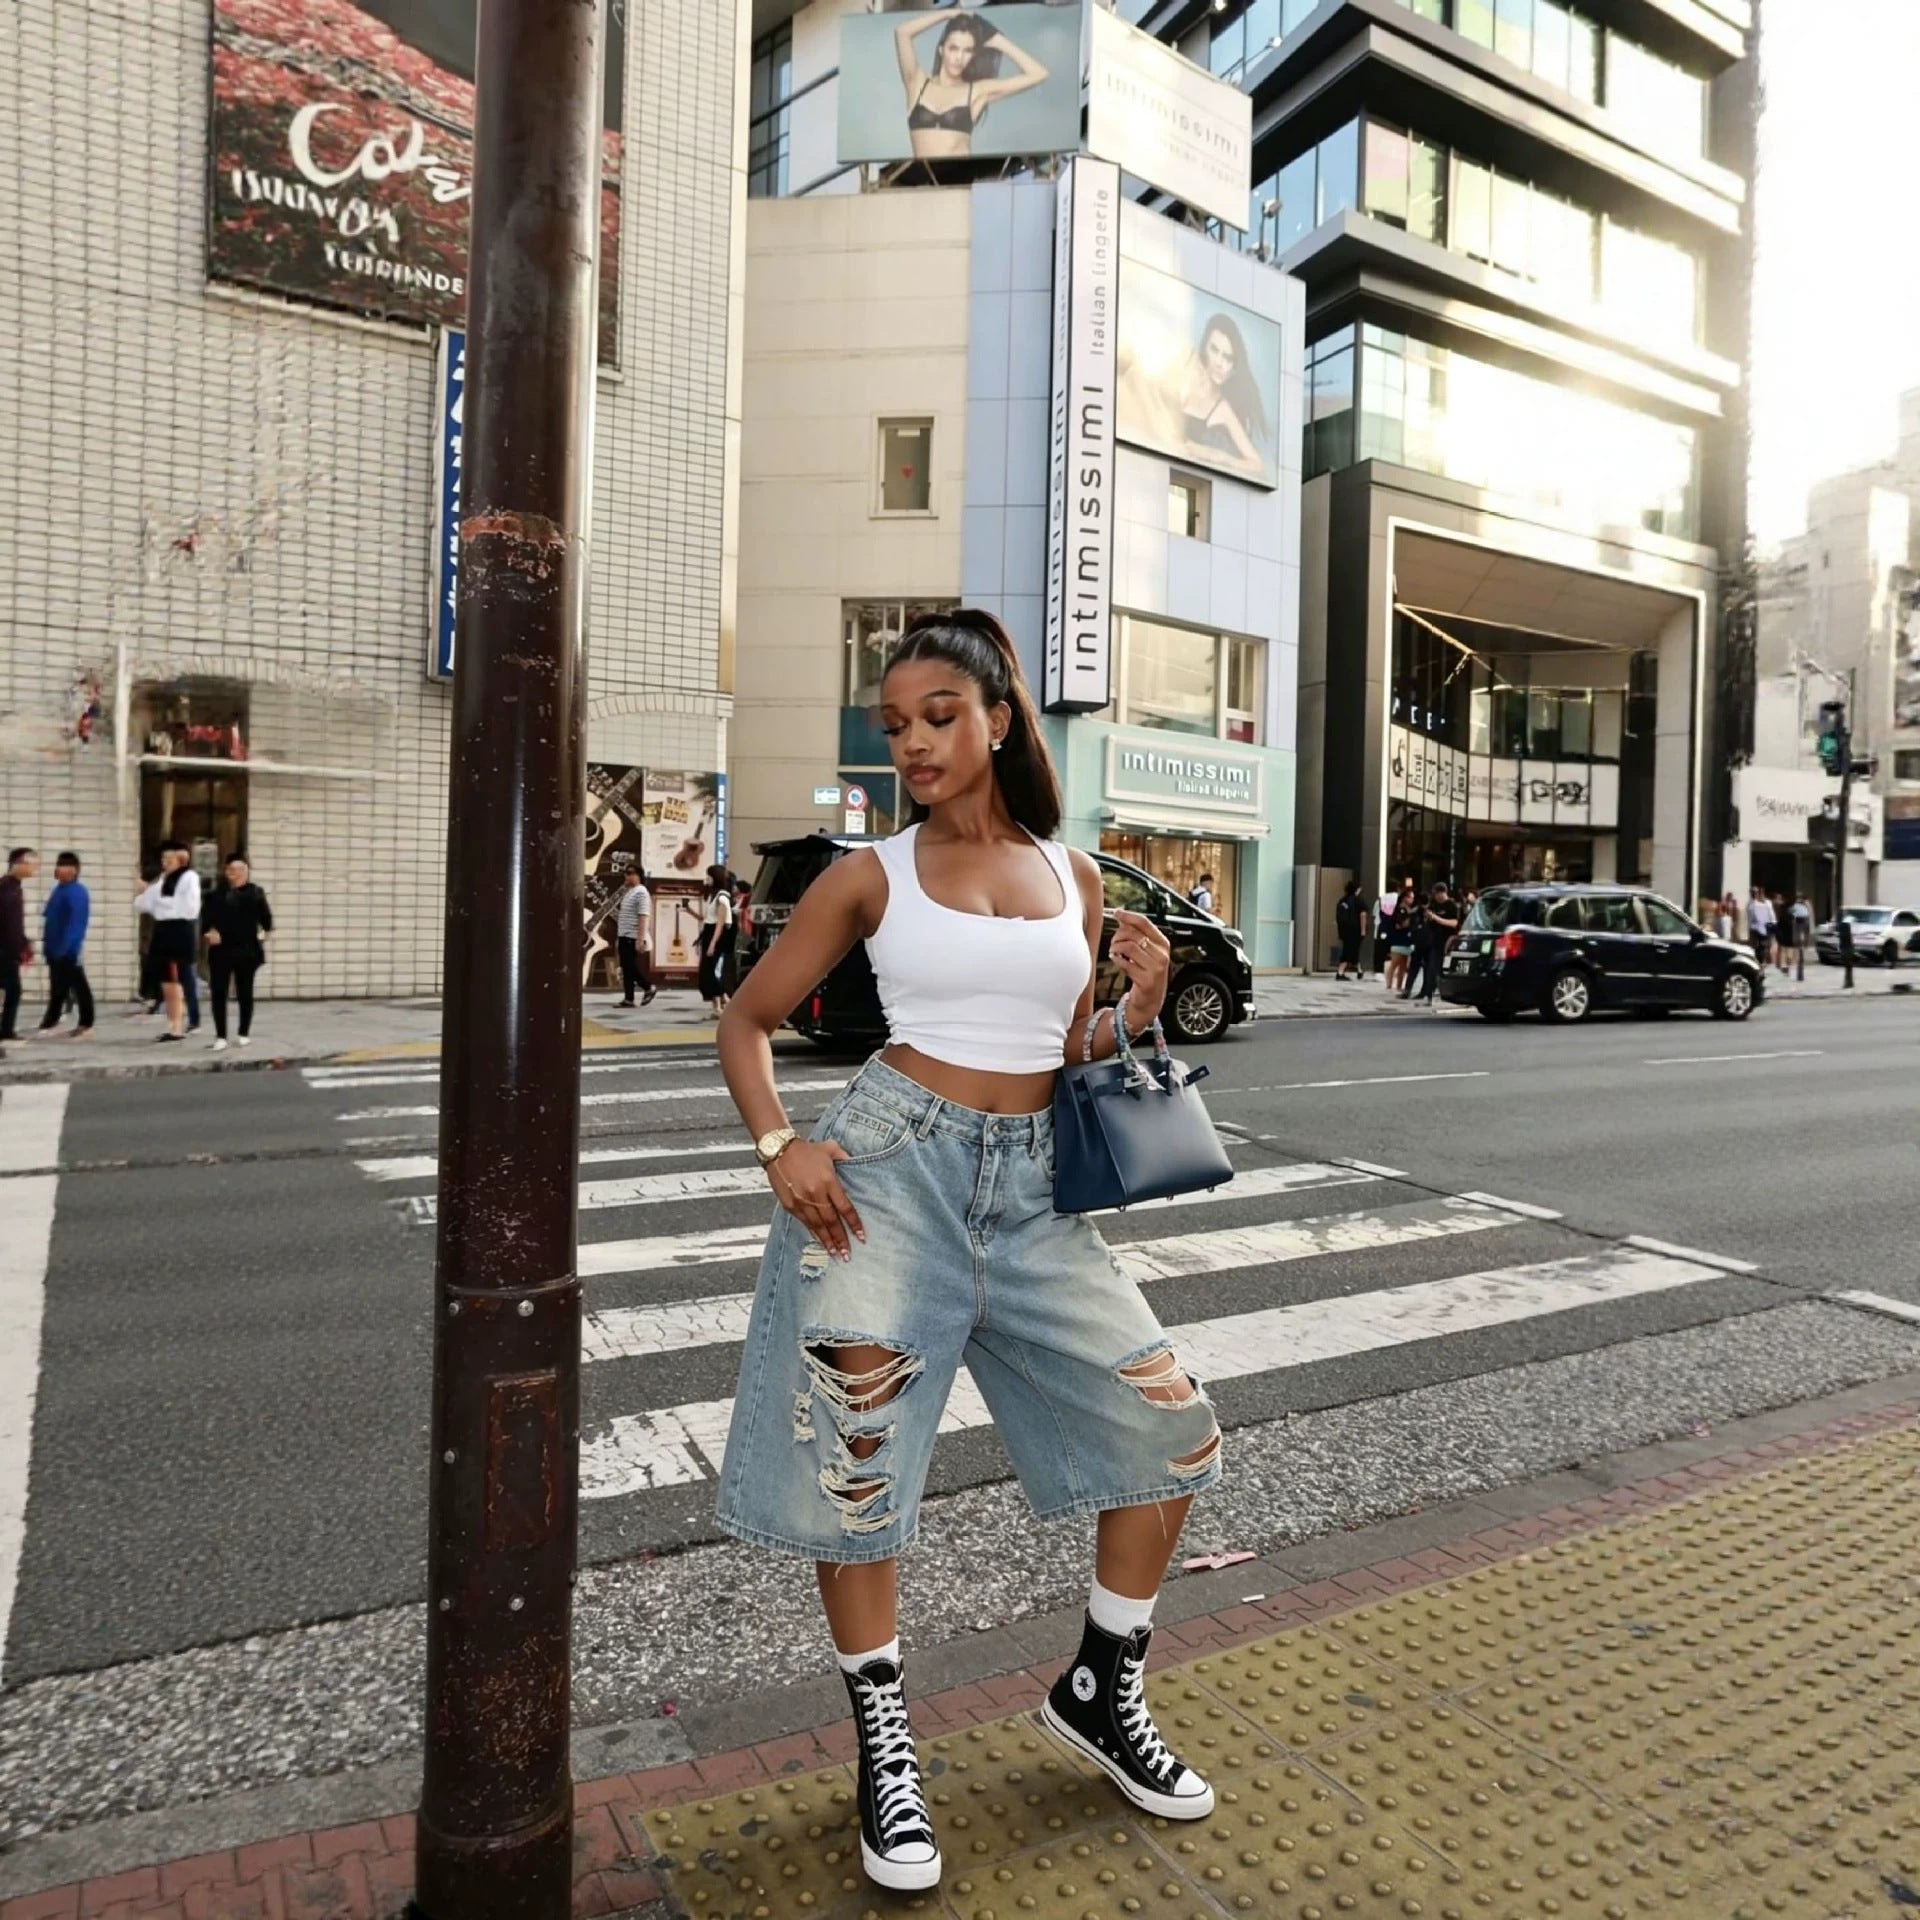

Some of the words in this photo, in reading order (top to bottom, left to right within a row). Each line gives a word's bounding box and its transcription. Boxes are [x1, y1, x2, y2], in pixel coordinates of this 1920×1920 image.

[1072, 385, 1103, 671] intimissimi
[1090, 286, 1105, 355] Italian
[1123, 751, 1251, 785] intimissimi
